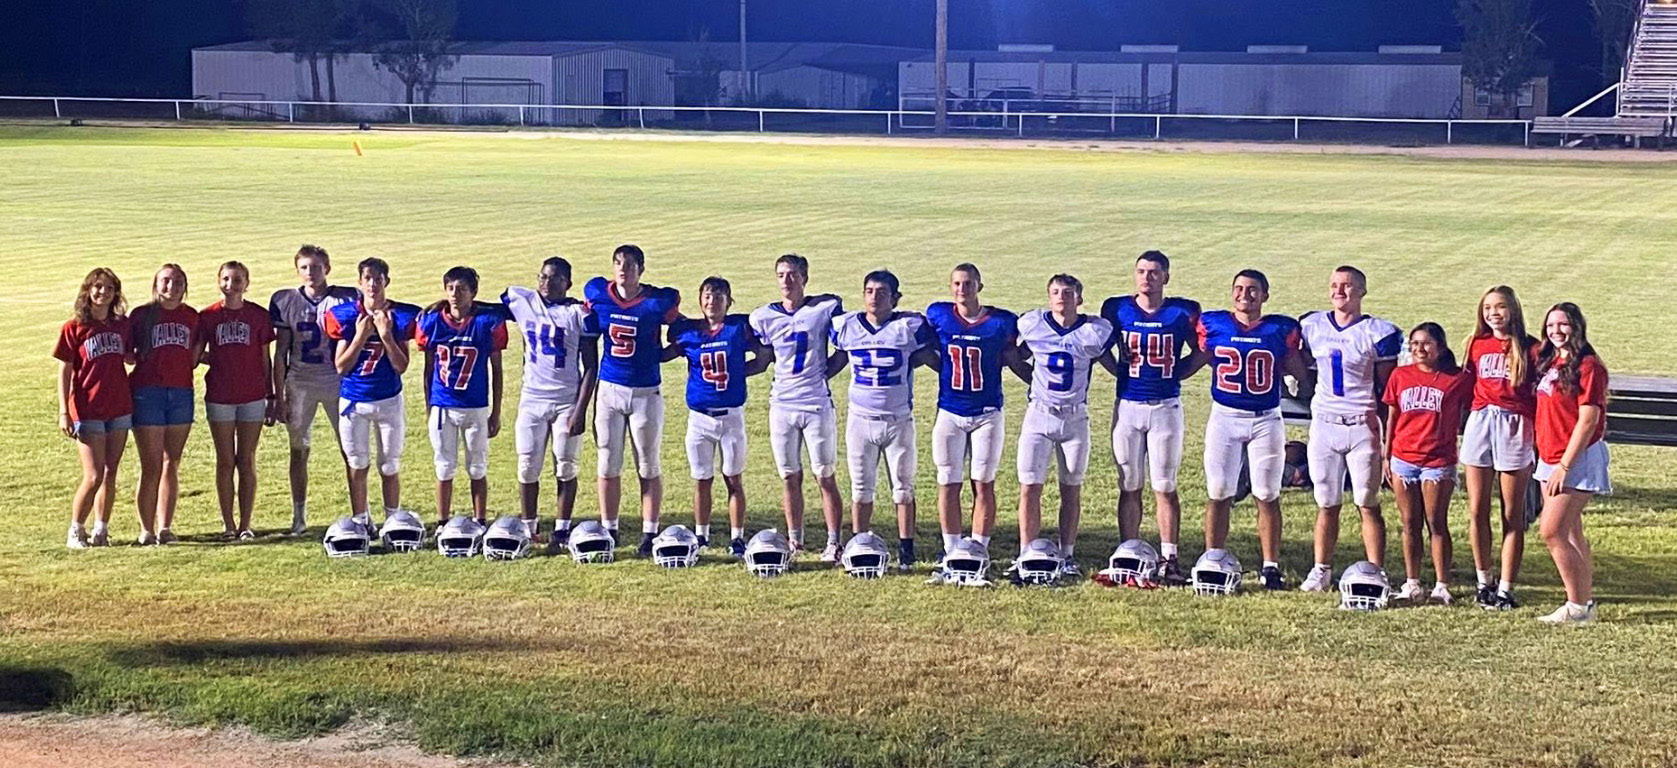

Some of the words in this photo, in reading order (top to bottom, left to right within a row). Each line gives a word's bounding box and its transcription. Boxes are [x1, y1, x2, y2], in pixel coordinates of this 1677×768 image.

[83, 332, 124, 361] VALLEY
[152, 322, 190, 349] VALLEY
[217, 322, 251, 346] VALLEY
[526, 320, 568, 369] 14
[609, 323, 637, 358] 5
[783, 331, 809, 375] 7
[1121, 330, 1175, 378] 44
[360, 342, 385, 376] 7
[700, 351, 730, 391] 4
[851, 349, 903, 387] 22
[948, 345, 984, 392] 11
[1047, 351, 1074, 392] 9
[1214, 346, 1275, 394] 20
[1330, 349, 1345, 396] 1
[1399, 386, 1445, 413] VALLEY
